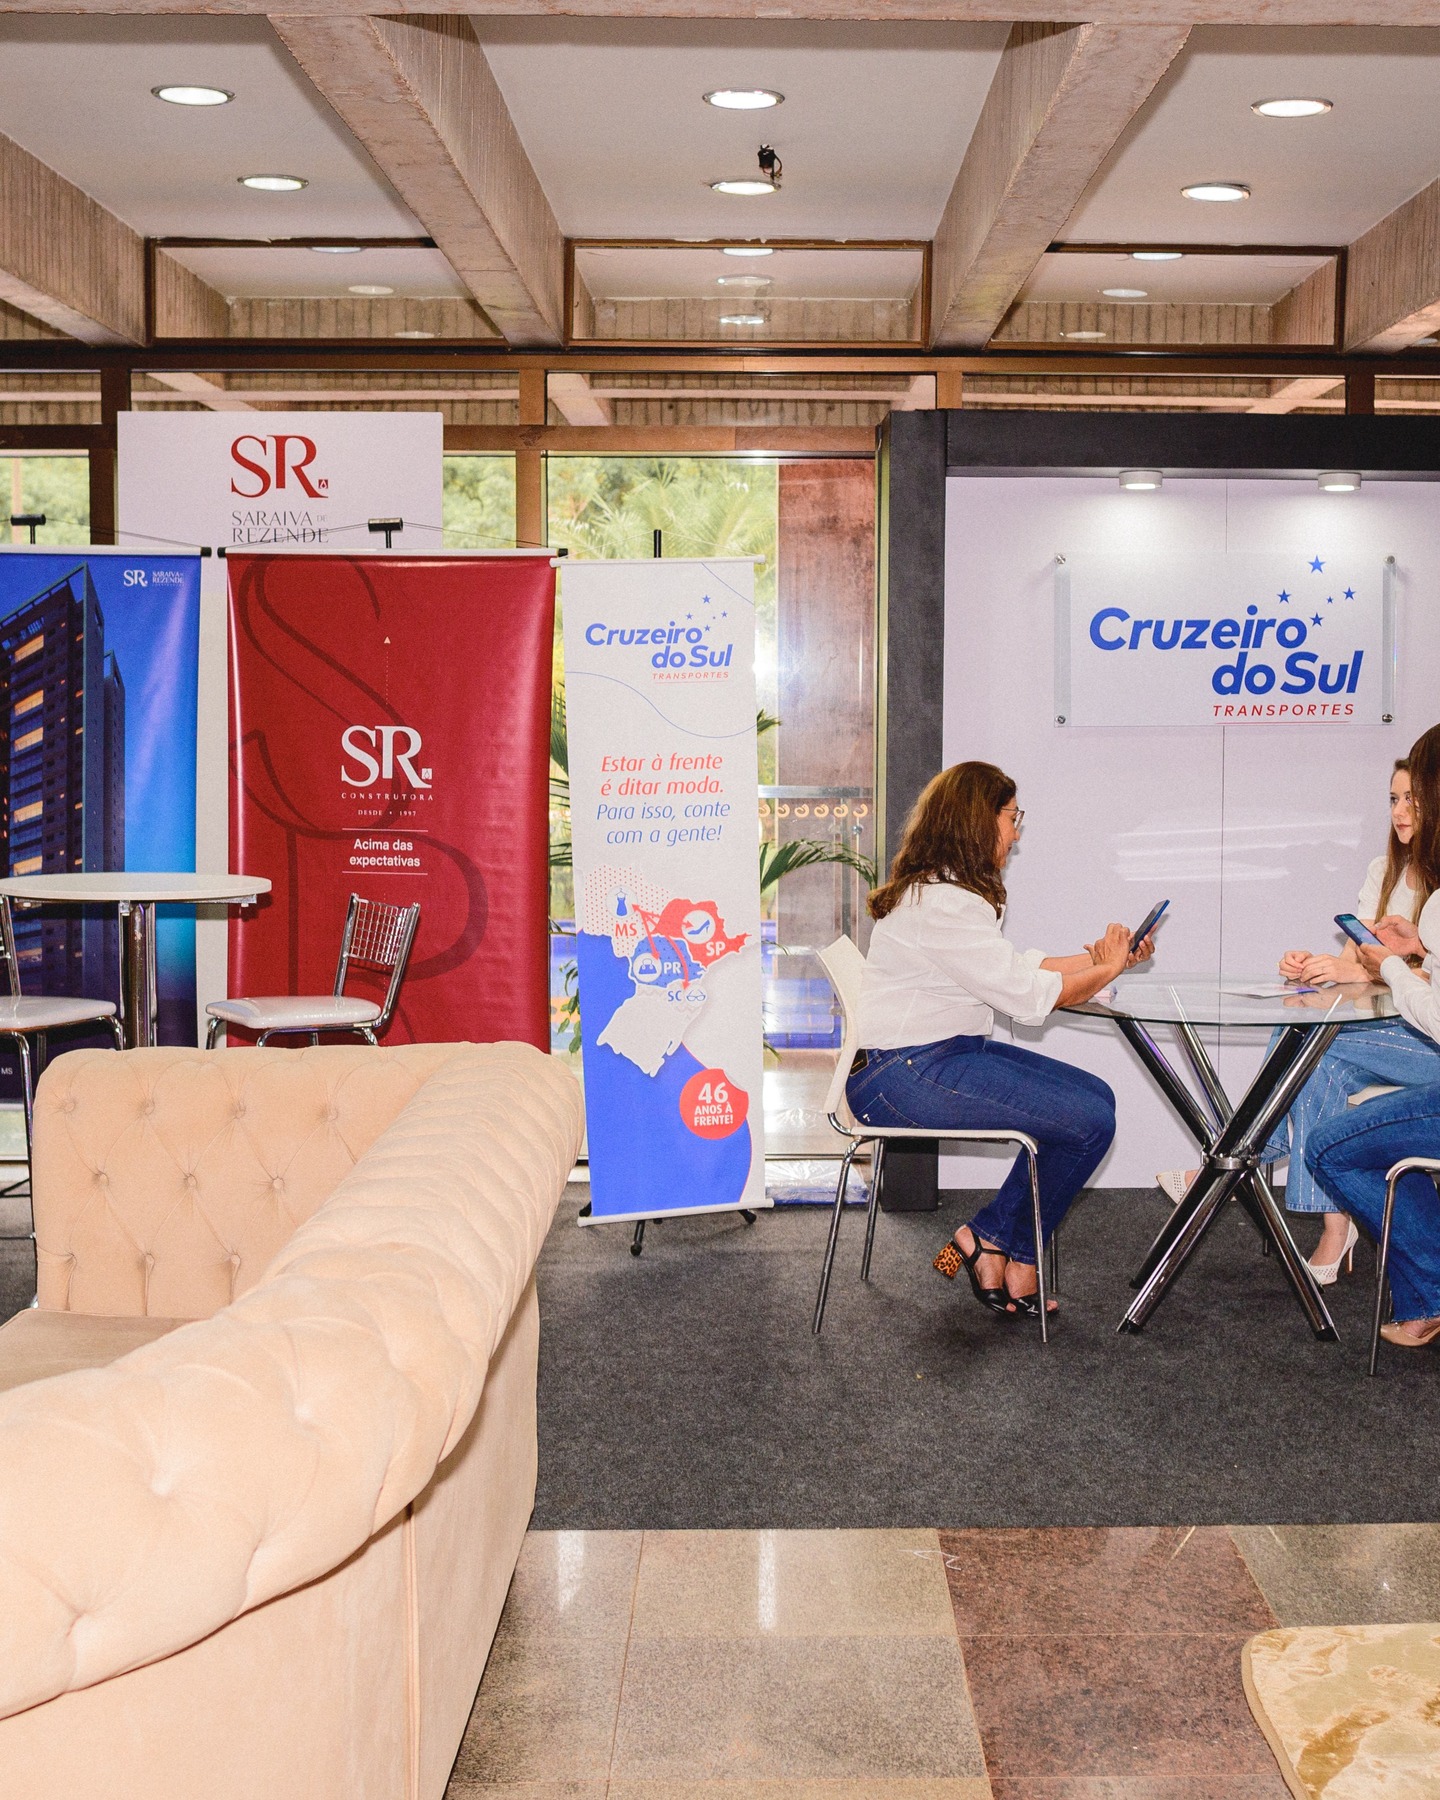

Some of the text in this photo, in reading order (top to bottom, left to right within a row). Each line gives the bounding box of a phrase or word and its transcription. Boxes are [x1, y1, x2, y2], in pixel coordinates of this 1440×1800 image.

[232, 511, 313, 526] SARAIVA
[232, 528, 329, 543] REZENDE
[585, 621, 703, 646] Cruzeiro
[1089, 604, 1308, 651] Cruzeiro
[651, 644, 734, 669] do Sul
[652, 671, 729, 680] TRANSPORTES
[1211, 650, 1364, 695] do Sul
[1213, 703, 1355, 718] TRANSPORTES
[601, 752, 723, 772] Estar à frente
[600, 775, 724, 796] é ditar moda.
[341, 792, 434, 801] CONSTRUTORA
[596, 801, 731, 822] Para isso, conte
[606, 825, 722, 847] com a gente!
[353, 838, 414, 851] Acima das
[349, 854, 421, 868] expectativas
[615, 923, 638, 937] MS
[705, 941, 726, 957] SP
[663, 962, 682, 974] PR
[667, 990, 682, 1002] SC
[1, 1067, 13, 1075] MS
[698, 1082, 729, 1104] 46
[694, 1101, 733, 1116] ANOS À
[693, 1115, 734, 1127] FRENTE!
